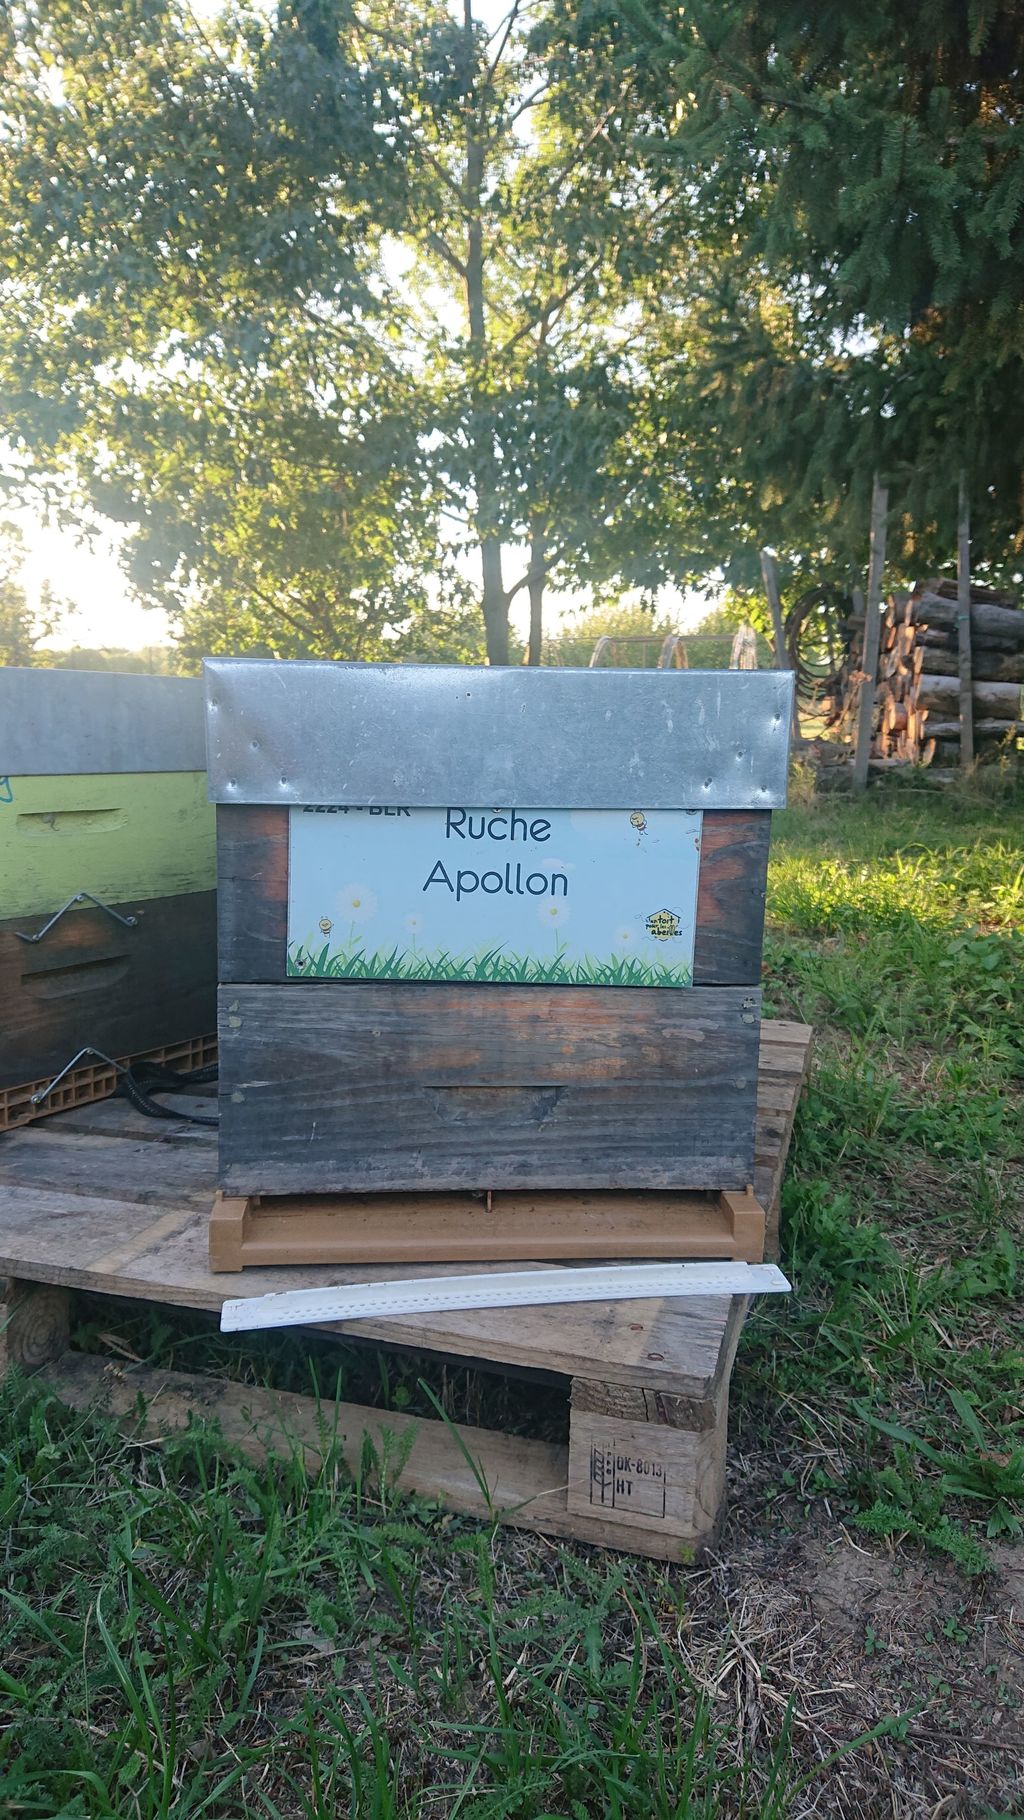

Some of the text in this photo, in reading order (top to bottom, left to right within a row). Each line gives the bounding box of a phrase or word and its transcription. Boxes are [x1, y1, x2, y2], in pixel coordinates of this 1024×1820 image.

[446, 807, 551, 842] Ruche
[422, 860, 568, 902] Apollon
[616, 1478, 633, 1496] HT
